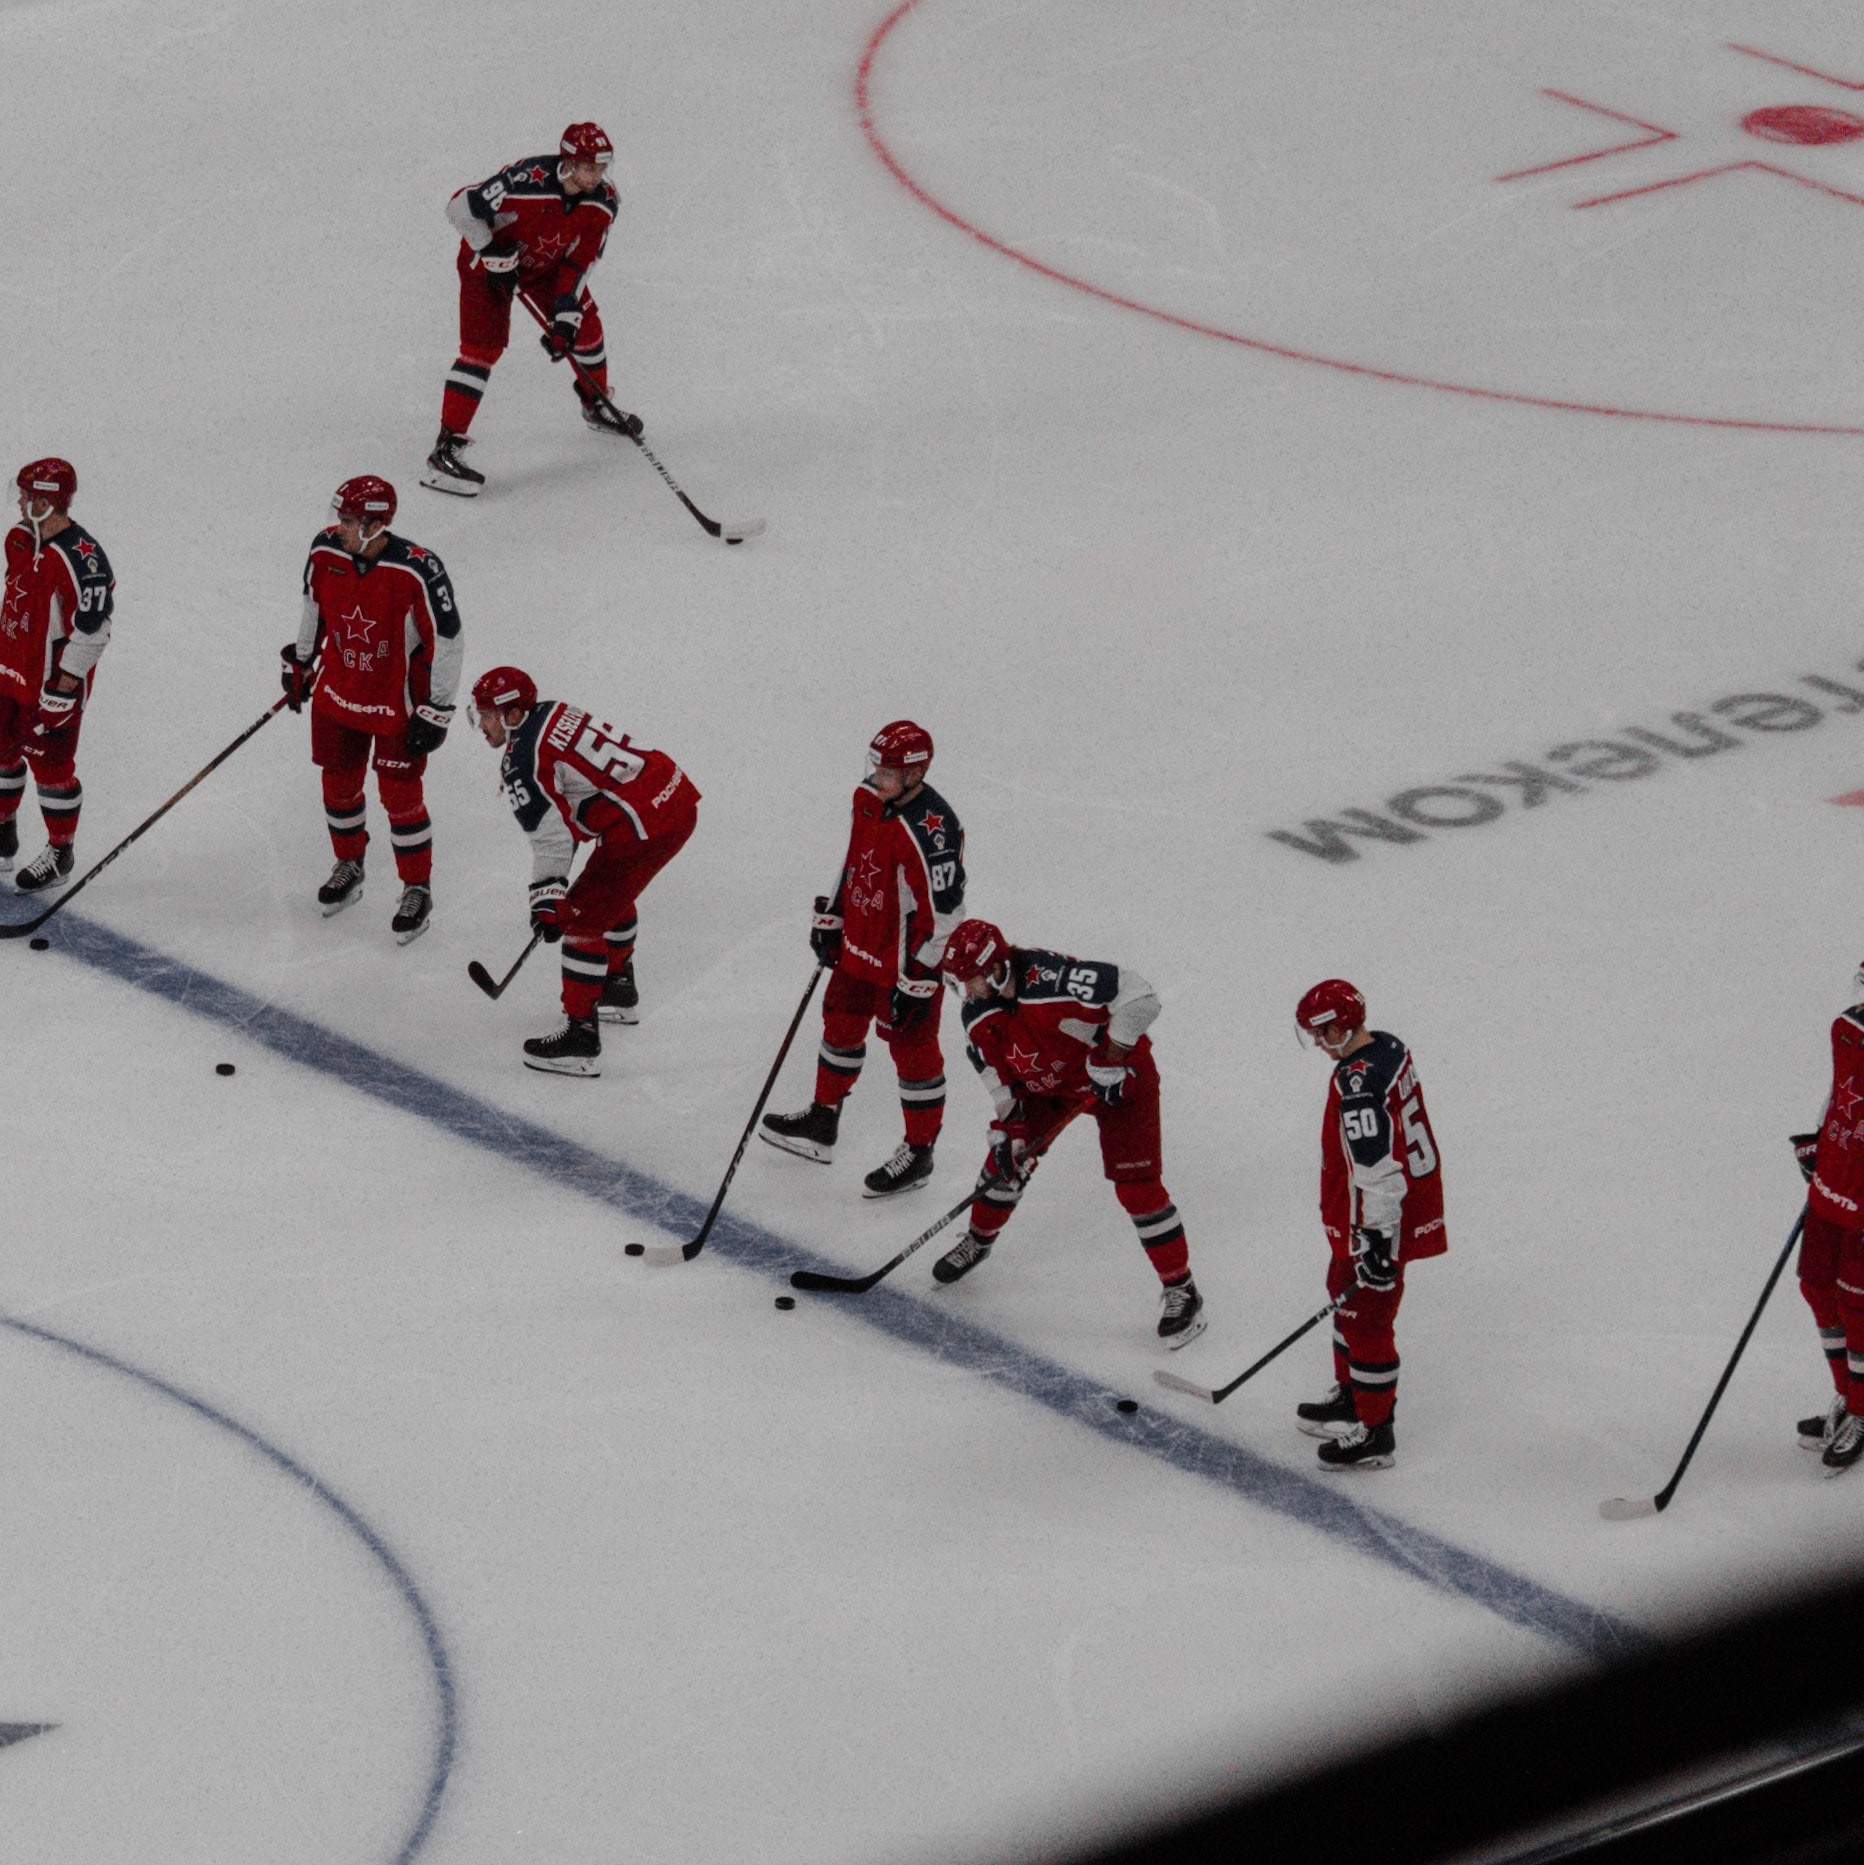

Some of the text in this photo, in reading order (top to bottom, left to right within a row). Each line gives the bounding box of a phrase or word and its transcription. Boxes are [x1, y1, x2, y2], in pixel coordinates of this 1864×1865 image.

[78, 586, 108, 613] 37
[437, 585, 453, 613] 3
[931, 861, 957, 893] 87
[1066, 968, 1098, 1001] 35
[1343, 1106, 1379, 1142] 50
